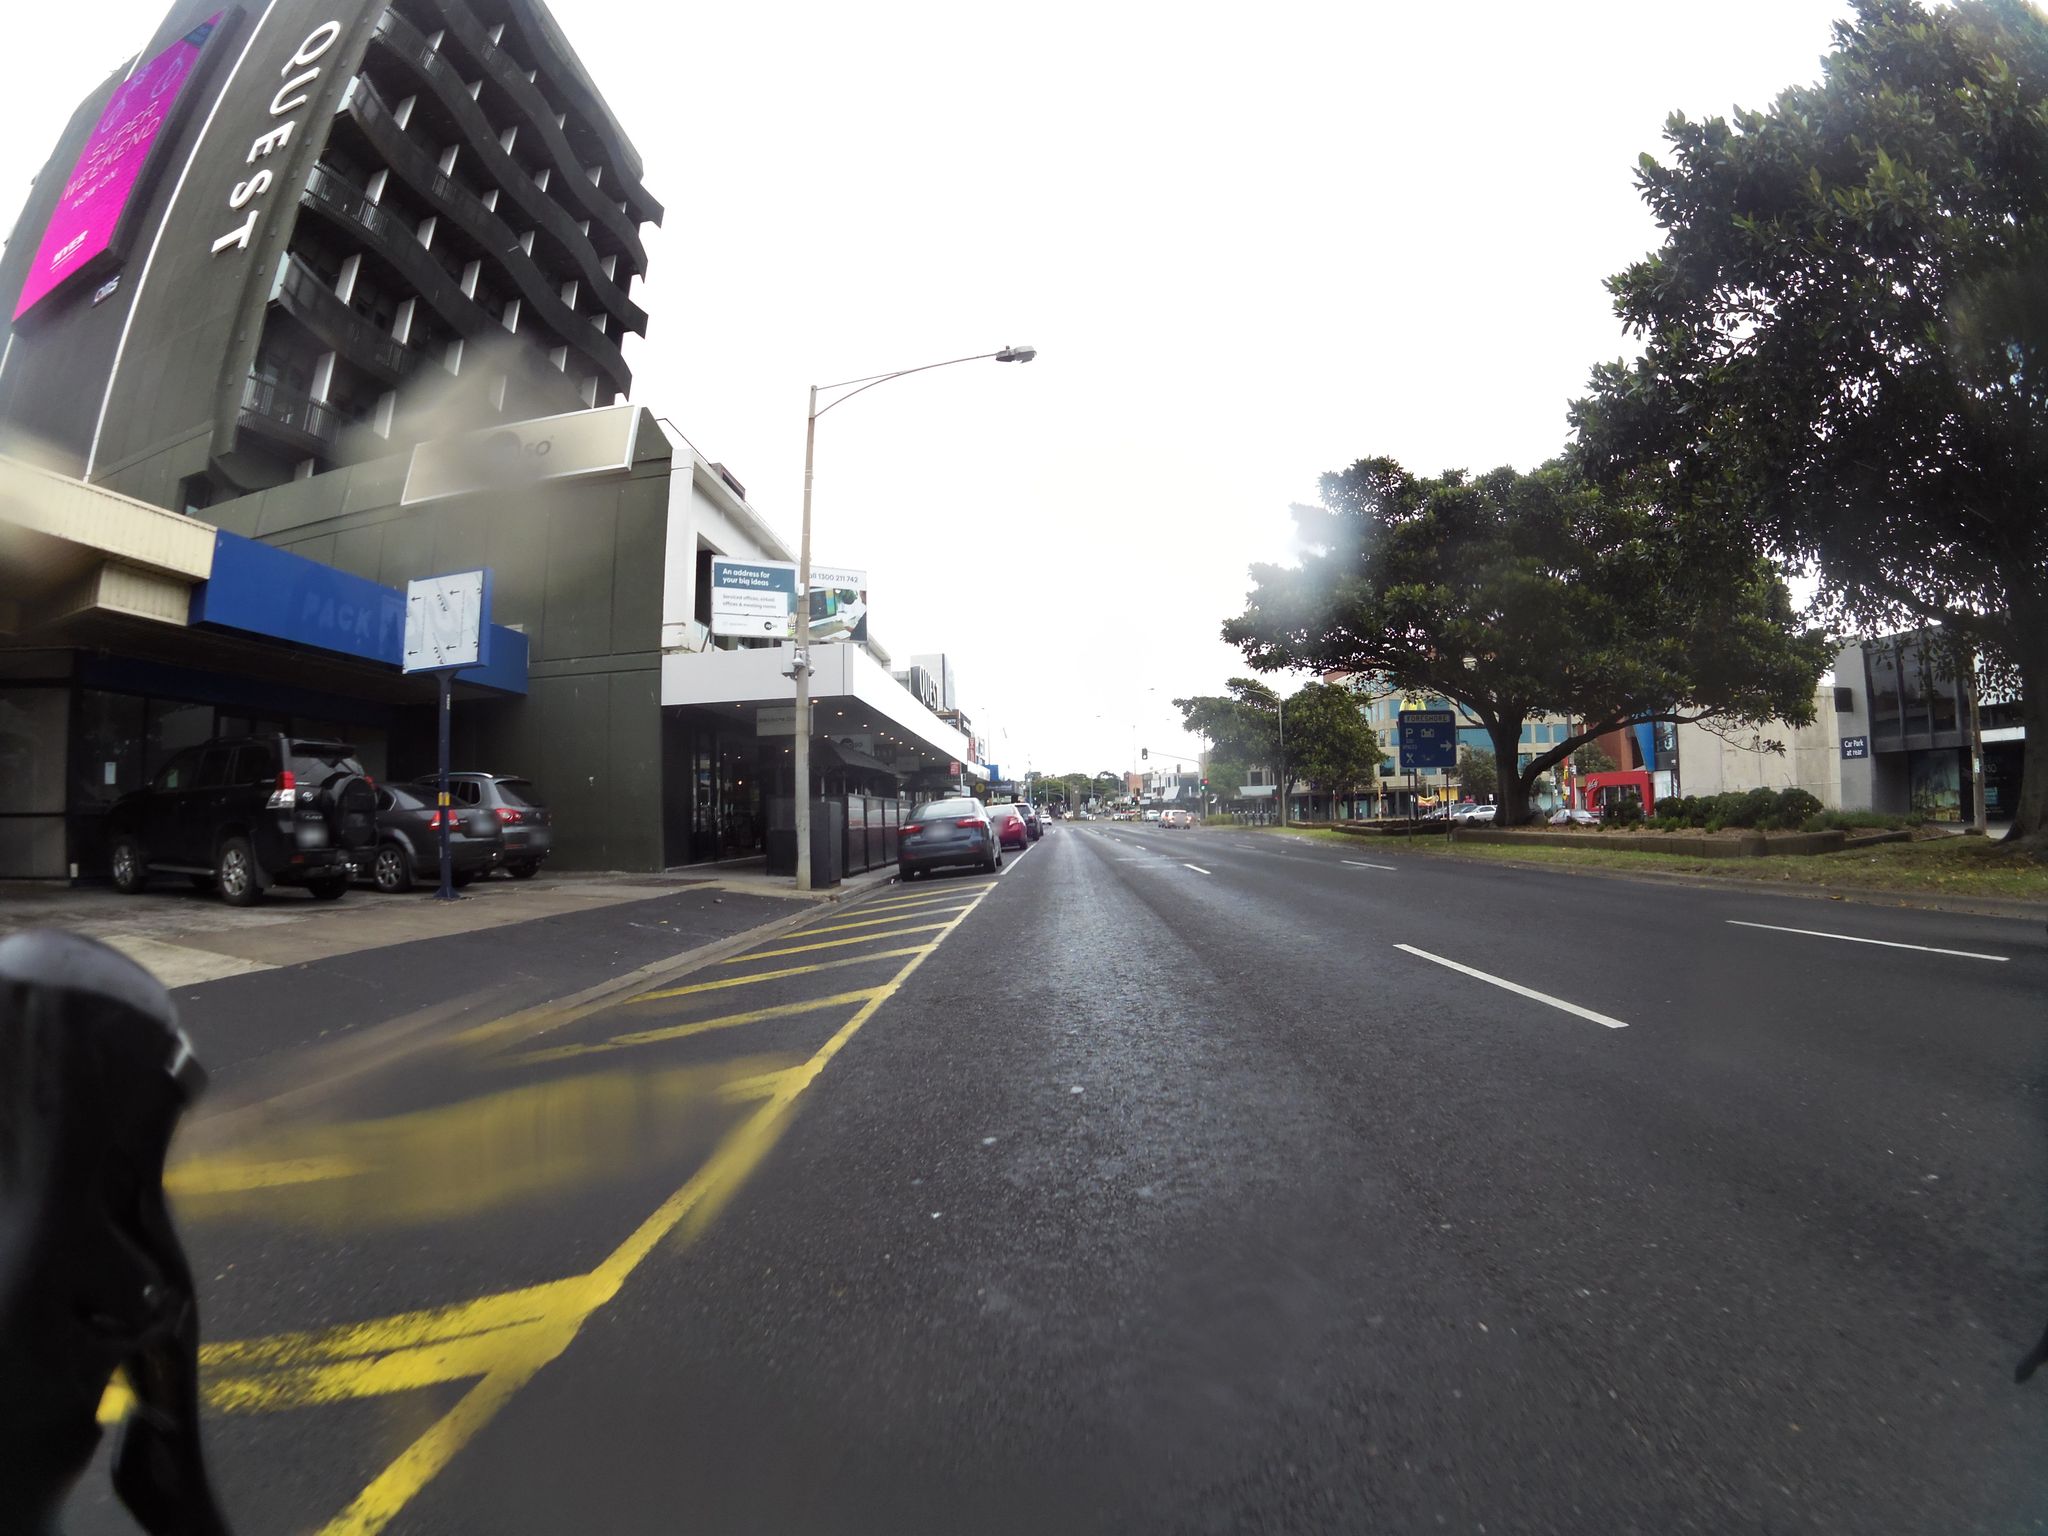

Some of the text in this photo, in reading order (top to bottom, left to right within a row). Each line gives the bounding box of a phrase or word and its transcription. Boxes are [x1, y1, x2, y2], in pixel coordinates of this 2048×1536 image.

[88, 100, 159, 165] SUPER
[211, 20, 341, 253] QUEST
[63, 116, 160, 201] WEEKEND
[98, 167, 119, 189] ON
[722, 567, 770, 579] An address for
[722, 577, 769, 586] your big ideas
[818, 573, 835, 581] 1300
[919, 665, 939, 711] QUEST
